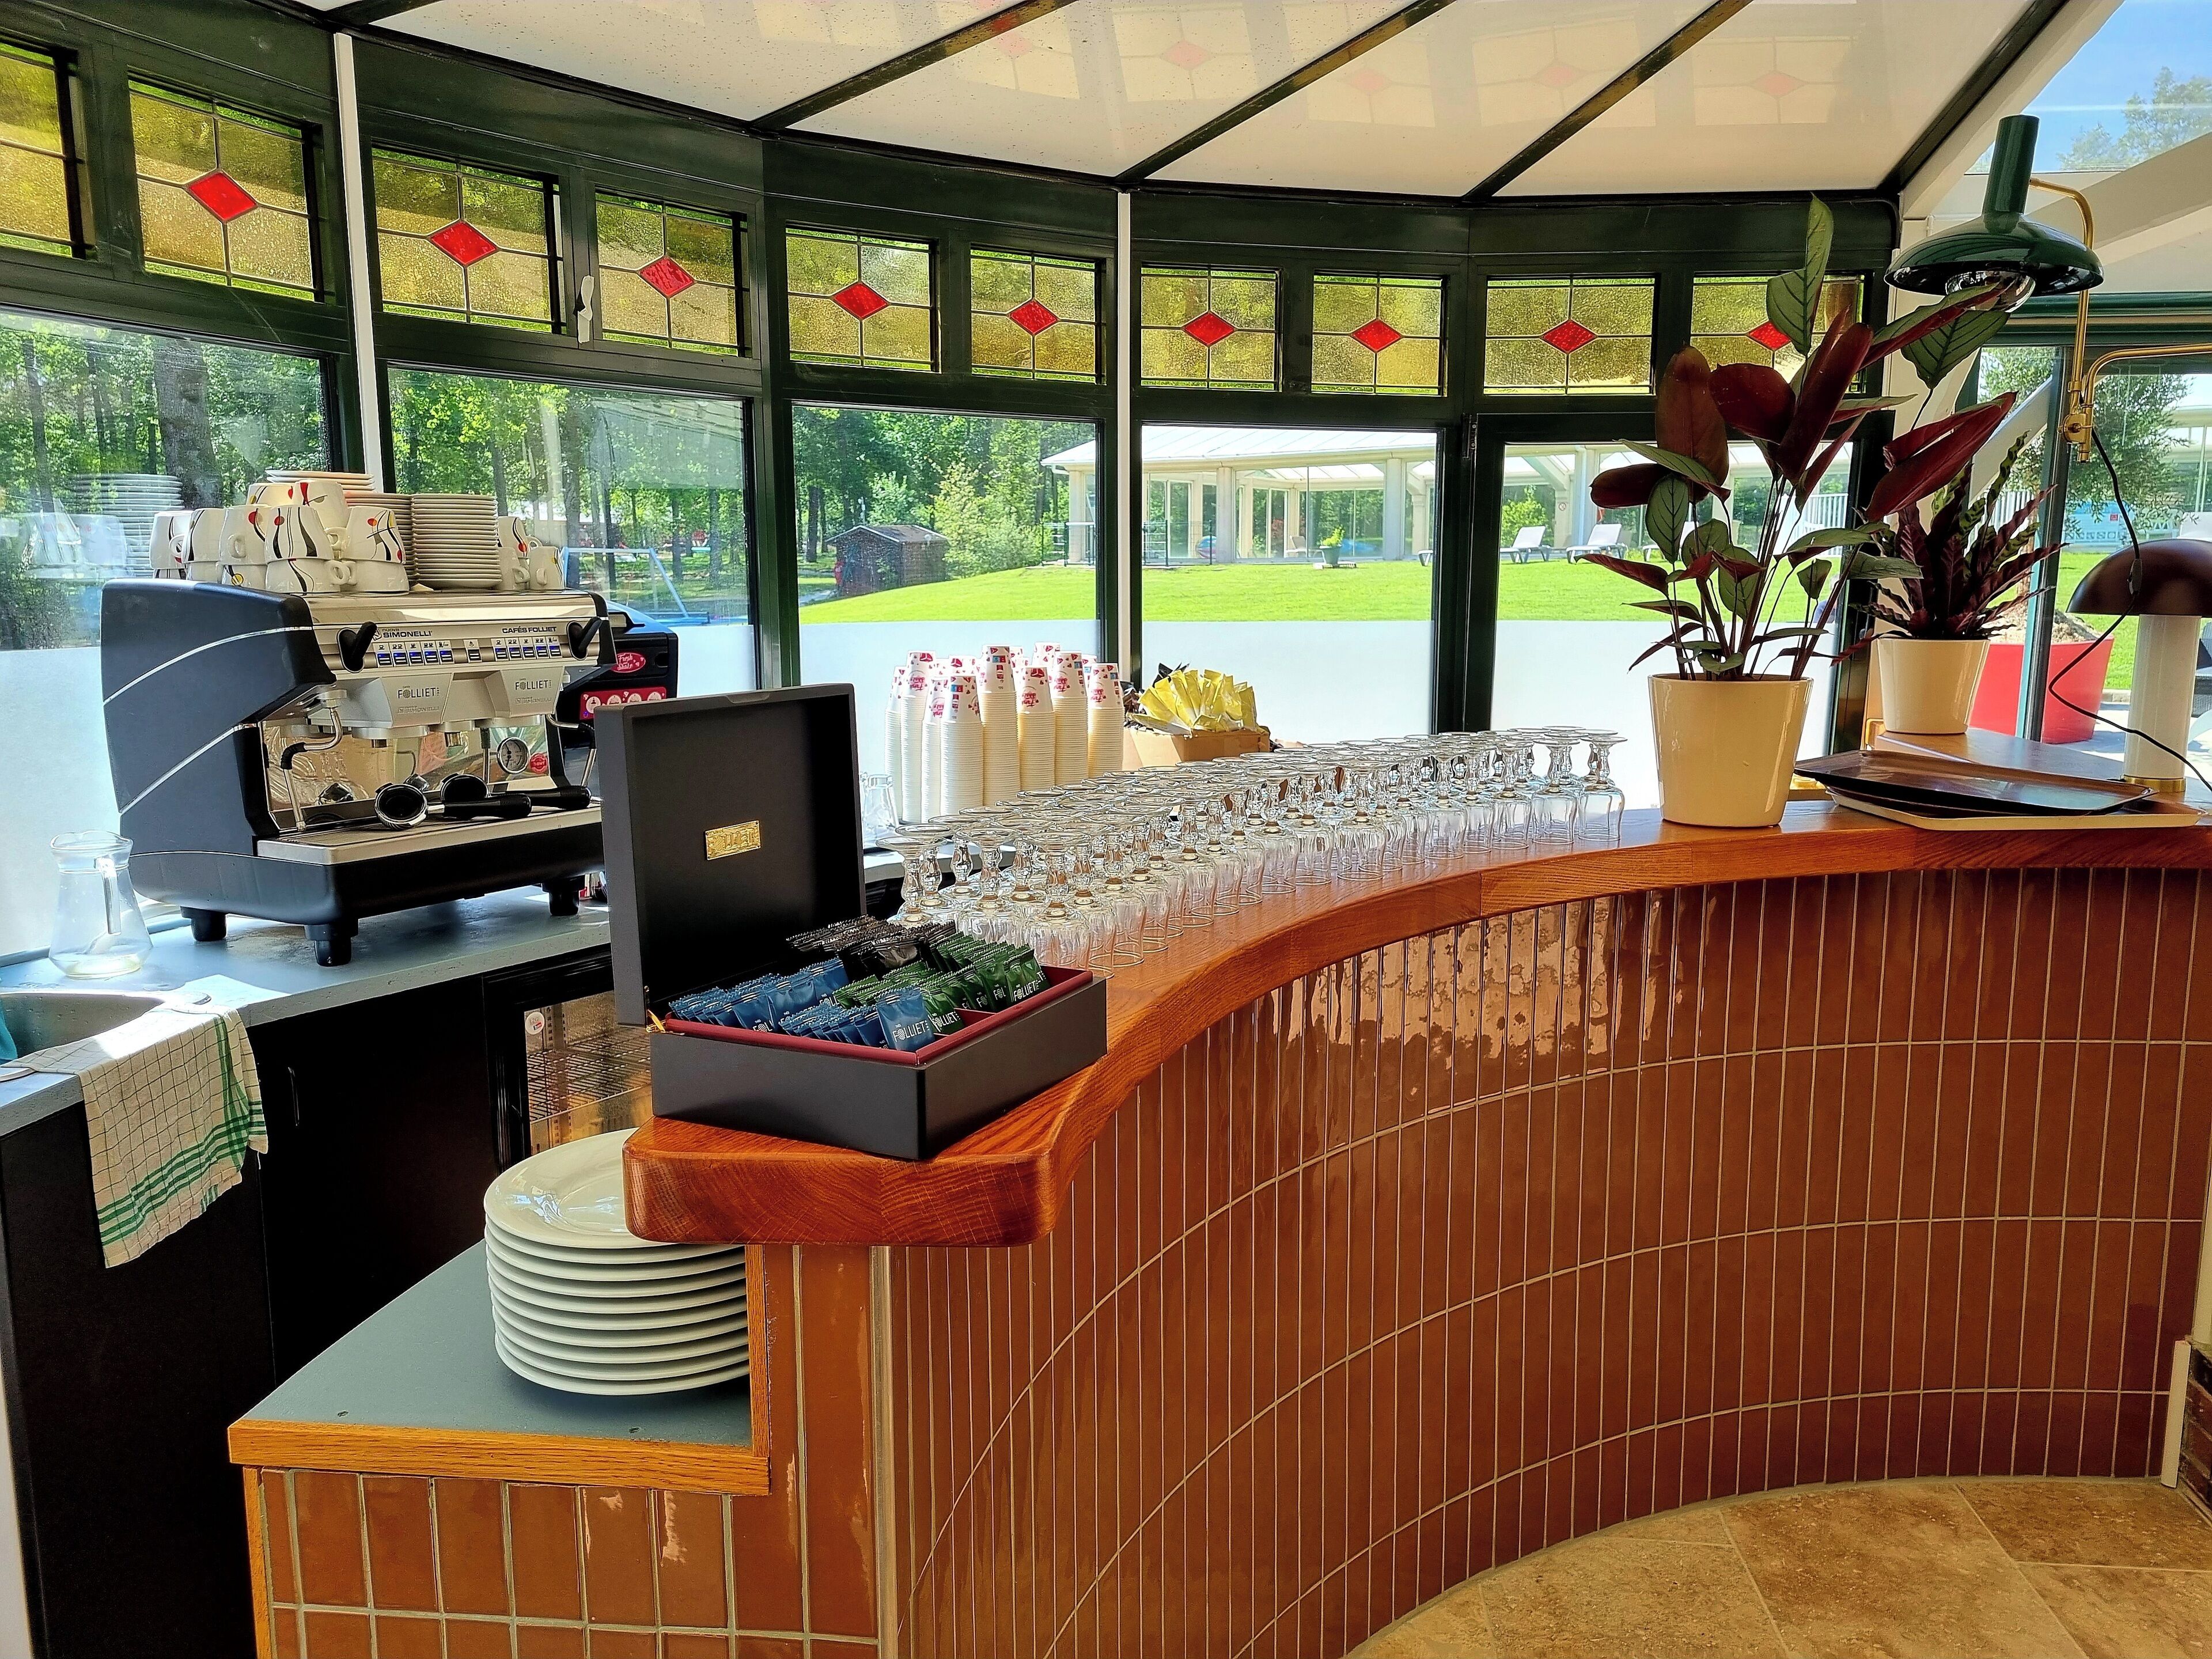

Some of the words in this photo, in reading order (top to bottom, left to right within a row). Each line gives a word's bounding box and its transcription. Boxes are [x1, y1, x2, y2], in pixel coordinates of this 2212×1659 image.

[502, 626, 527, 634] CAFÉS
[515, 680, 548, 690] FOLLIET
[398, 687, 436, 699] FOLLIET
[1013, 981, 1036, 1001] FOLLIET
[892, 1020, 926, 1043] FOLLIET
